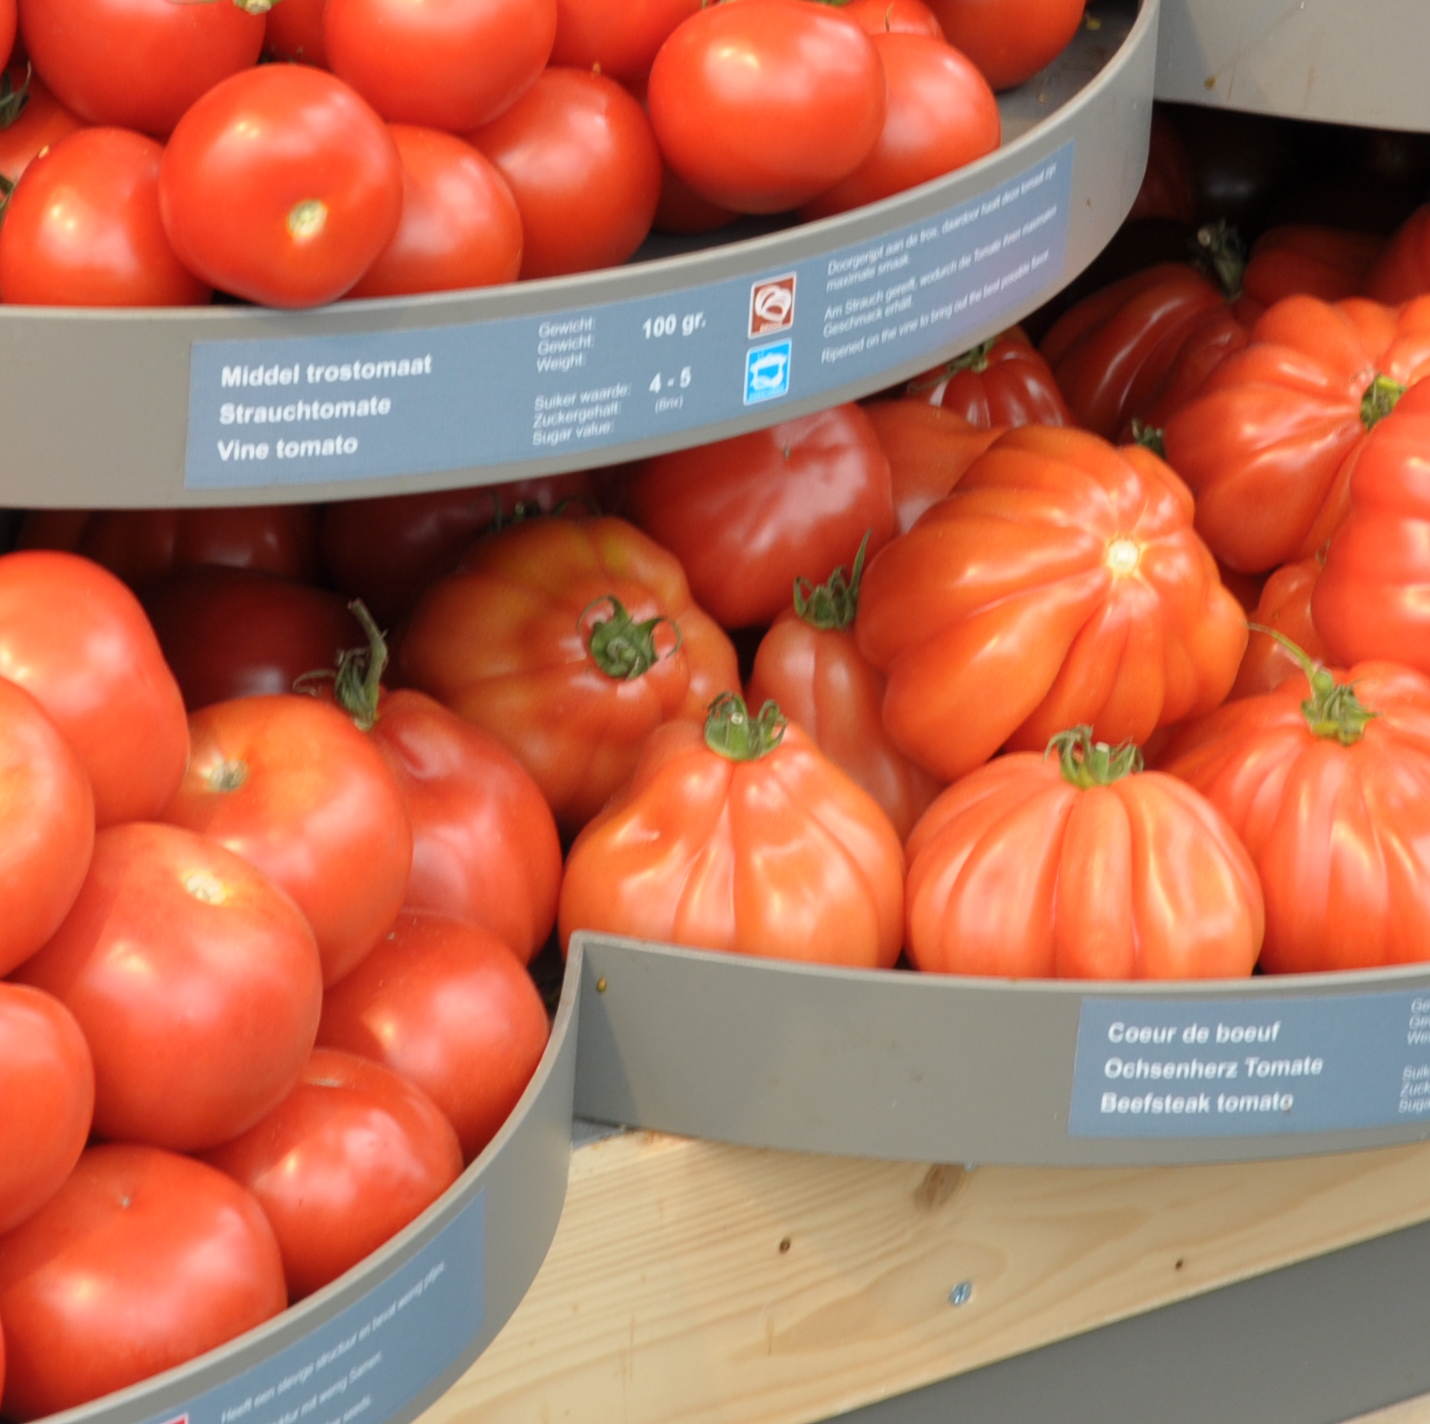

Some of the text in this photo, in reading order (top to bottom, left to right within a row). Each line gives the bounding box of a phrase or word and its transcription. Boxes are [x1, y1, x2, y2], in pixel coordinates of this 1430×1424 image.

[642, 312, 707, 339] 100 gr.
[220, 356, 433, 387] Middel trostomaat
[648, 372, 663, 394] 4
[679, 366, 692, 389] 5
[218, 397, 392, 424] Strauchtomate
[216, 436, 359, 461] Vine tomato
[1107, 1021, 1281, 1044] Coeur de boeuf
[1103, 1056, 1324, 1079] Ochsenherz Tomate
[1100, 1092, 1295, 1114] Beefsteak tomato
